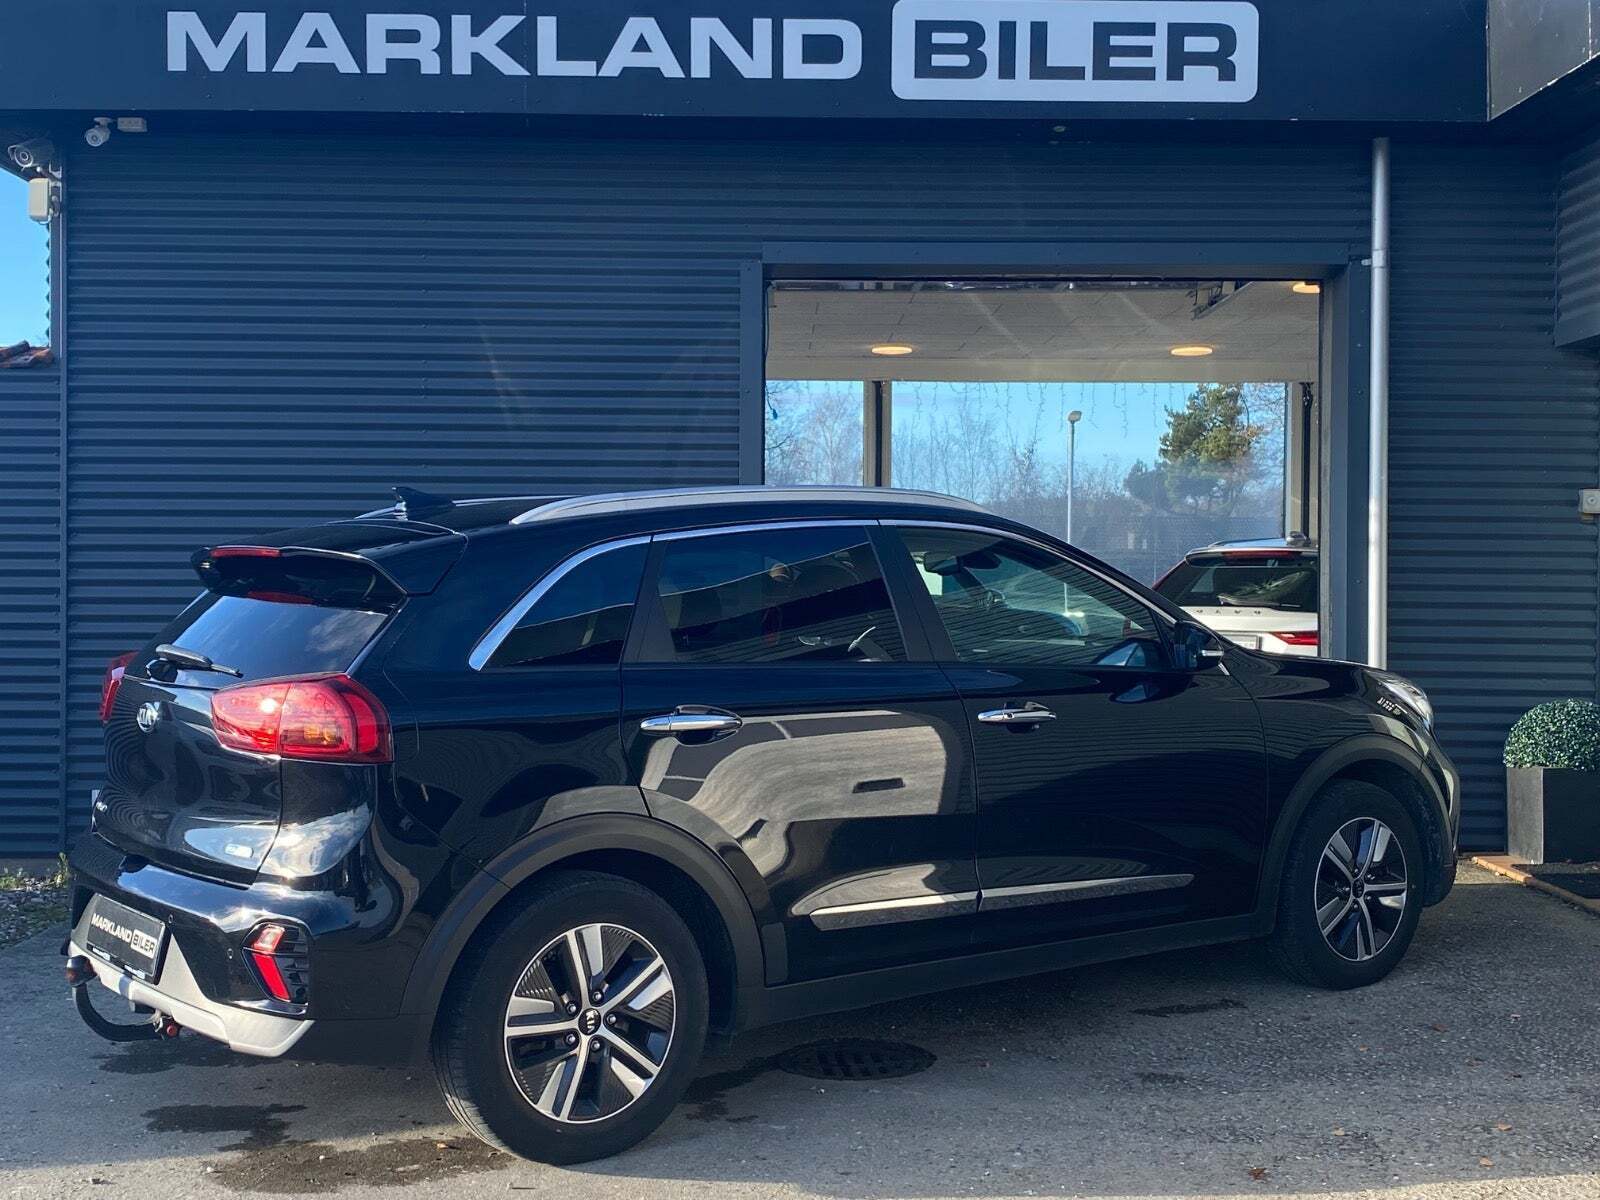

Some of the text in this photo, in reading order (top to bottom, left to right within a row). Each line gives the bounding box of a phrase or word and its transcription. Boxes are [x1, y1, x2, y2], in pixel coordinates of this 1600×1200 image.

[166, 11, 1238, 82] MARKLAND BILER
[91, 913, 132, 943] MARKLAND
[132, 933, 156, 954] BILER
[585, 1010, 599, 1034] KIA
